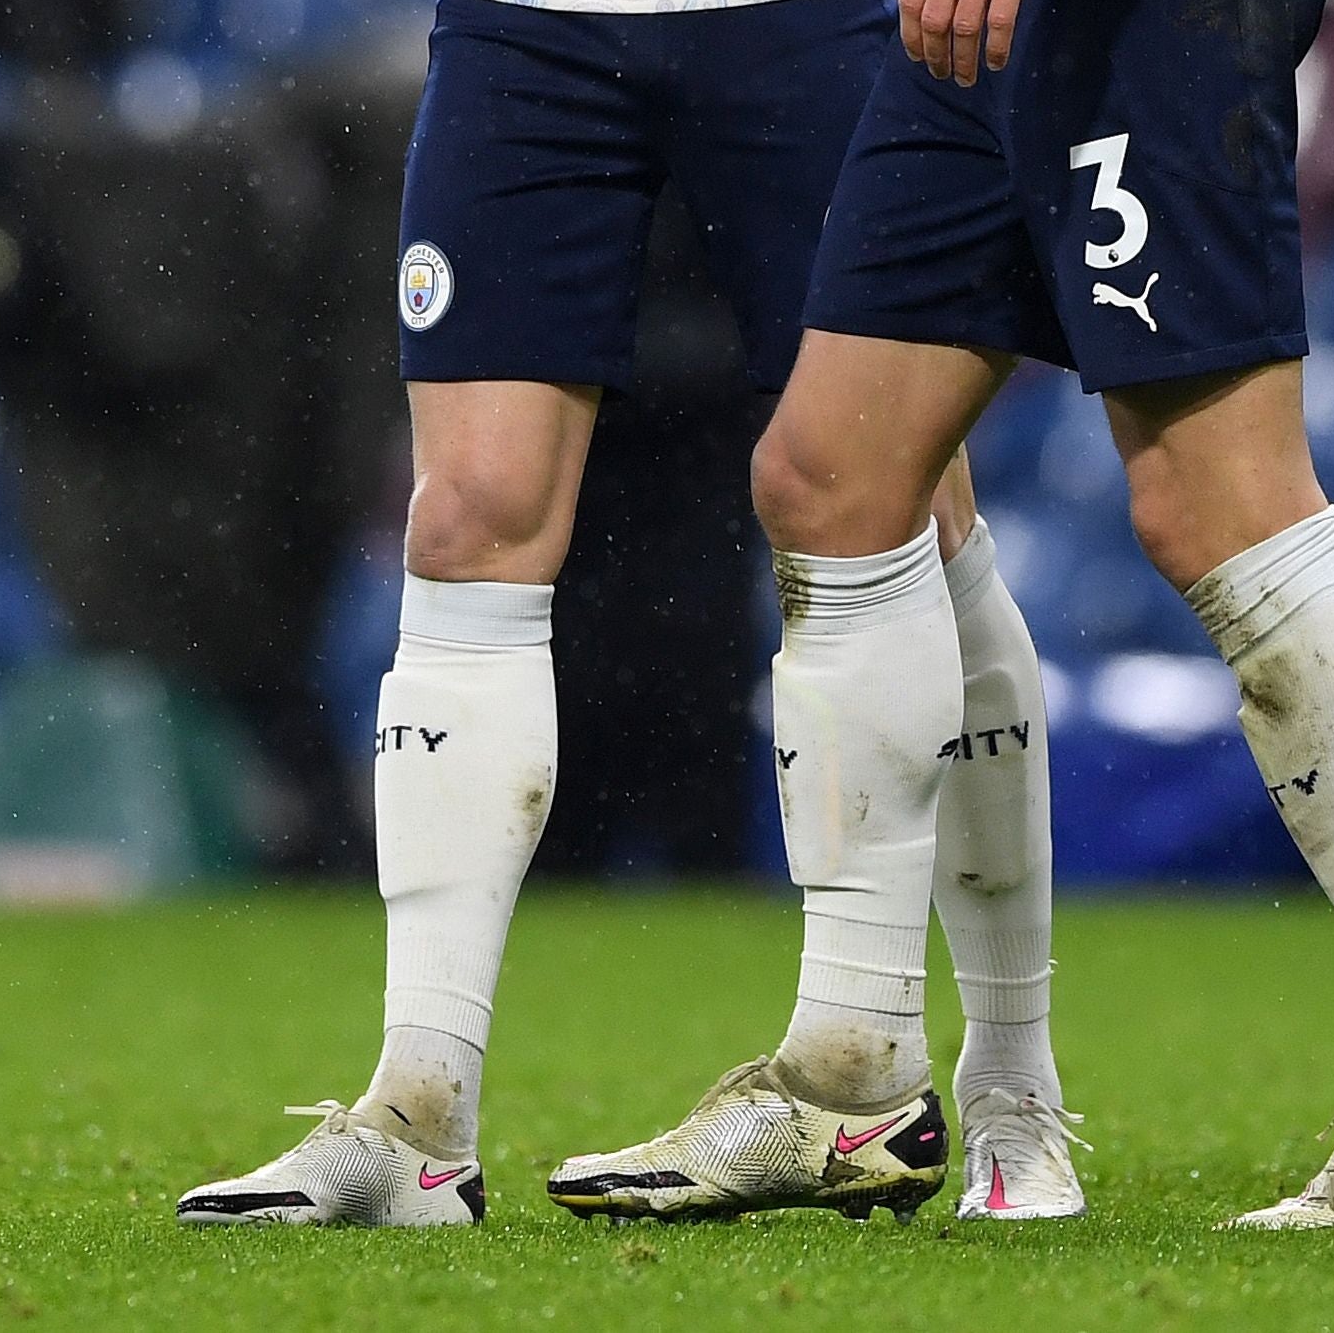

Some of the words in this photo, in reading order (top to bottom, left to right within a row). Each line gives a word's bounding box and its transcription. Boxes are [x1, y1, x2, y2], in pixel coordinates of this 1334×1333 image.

[1069, 133, 1148, 269] 3
[402, 249, 445, 274] MANCHESTER
[411, 316, 427, 325] CITY
[953, 720, 1029, 761] ITY
